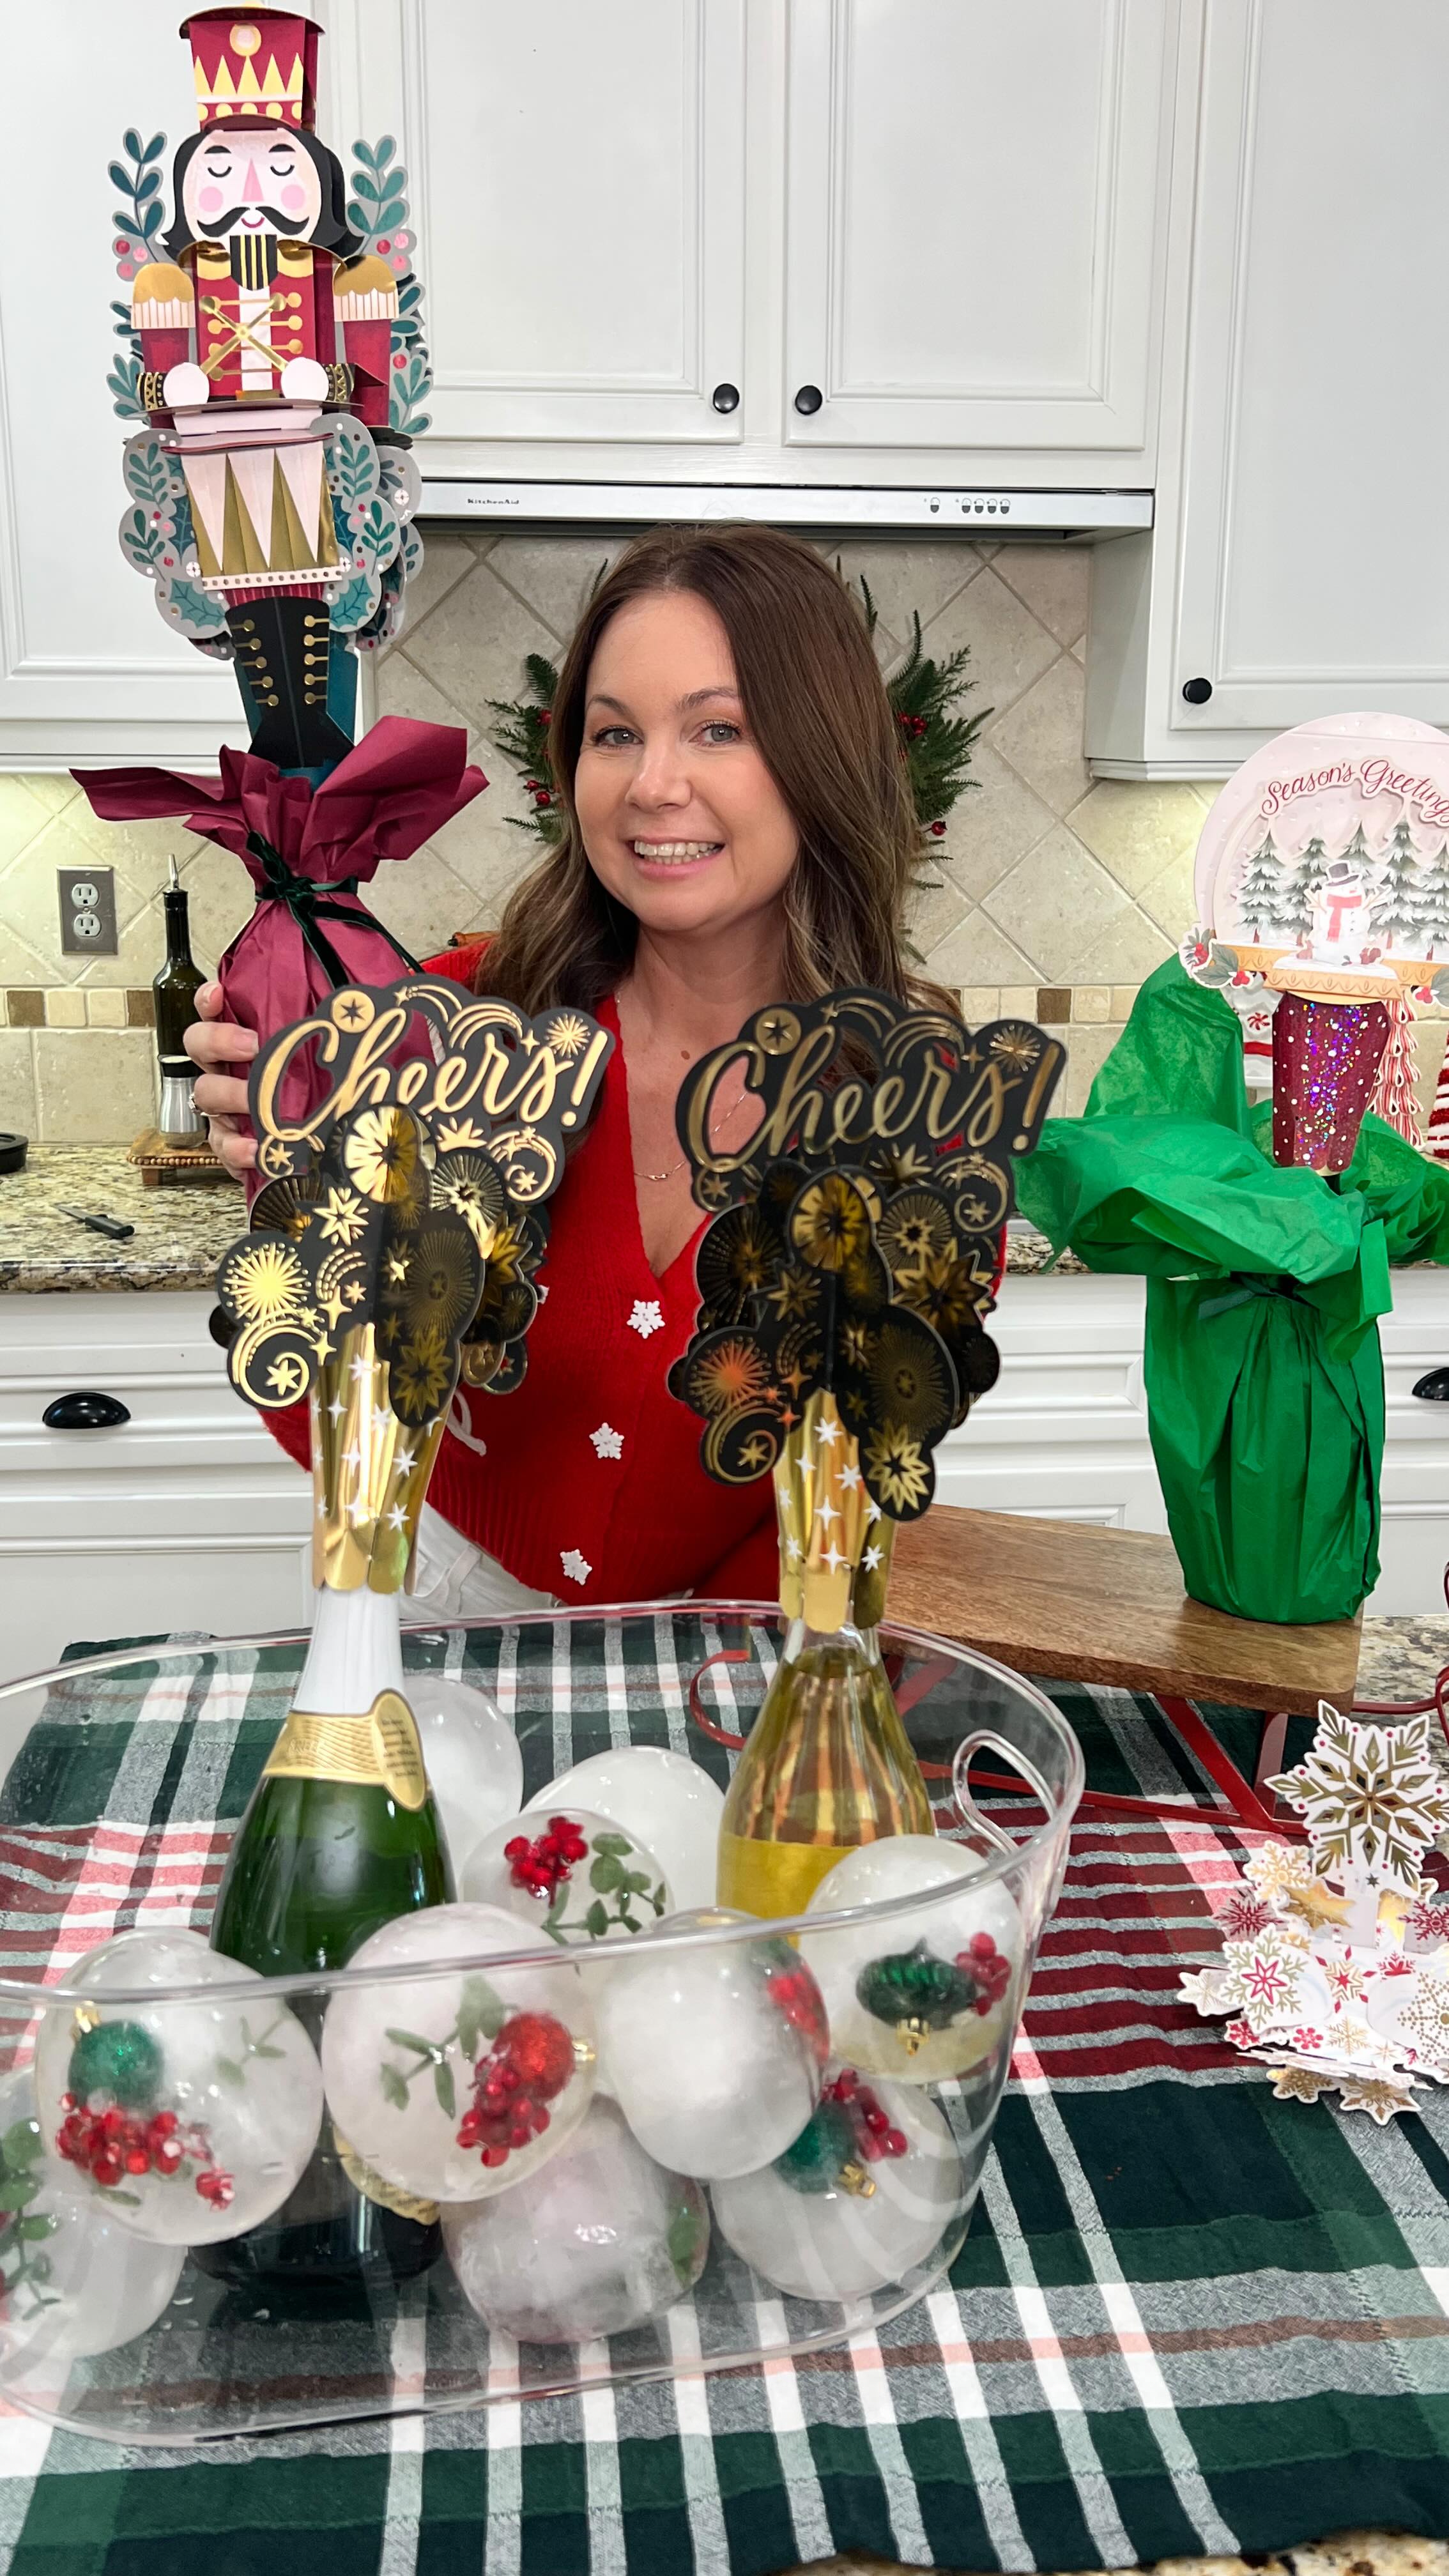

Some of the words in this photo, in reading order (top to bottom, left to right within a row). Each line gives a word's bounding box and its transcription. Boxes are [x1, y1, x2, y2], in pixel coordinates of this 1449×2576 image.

[1262, 763, 1356, 815] Season's
[1360, 759, 1449, 824] Greeting
[257, 1008, 608, 1142] Cheers!
[689, 1025, 1061, 1173] Cheers!
